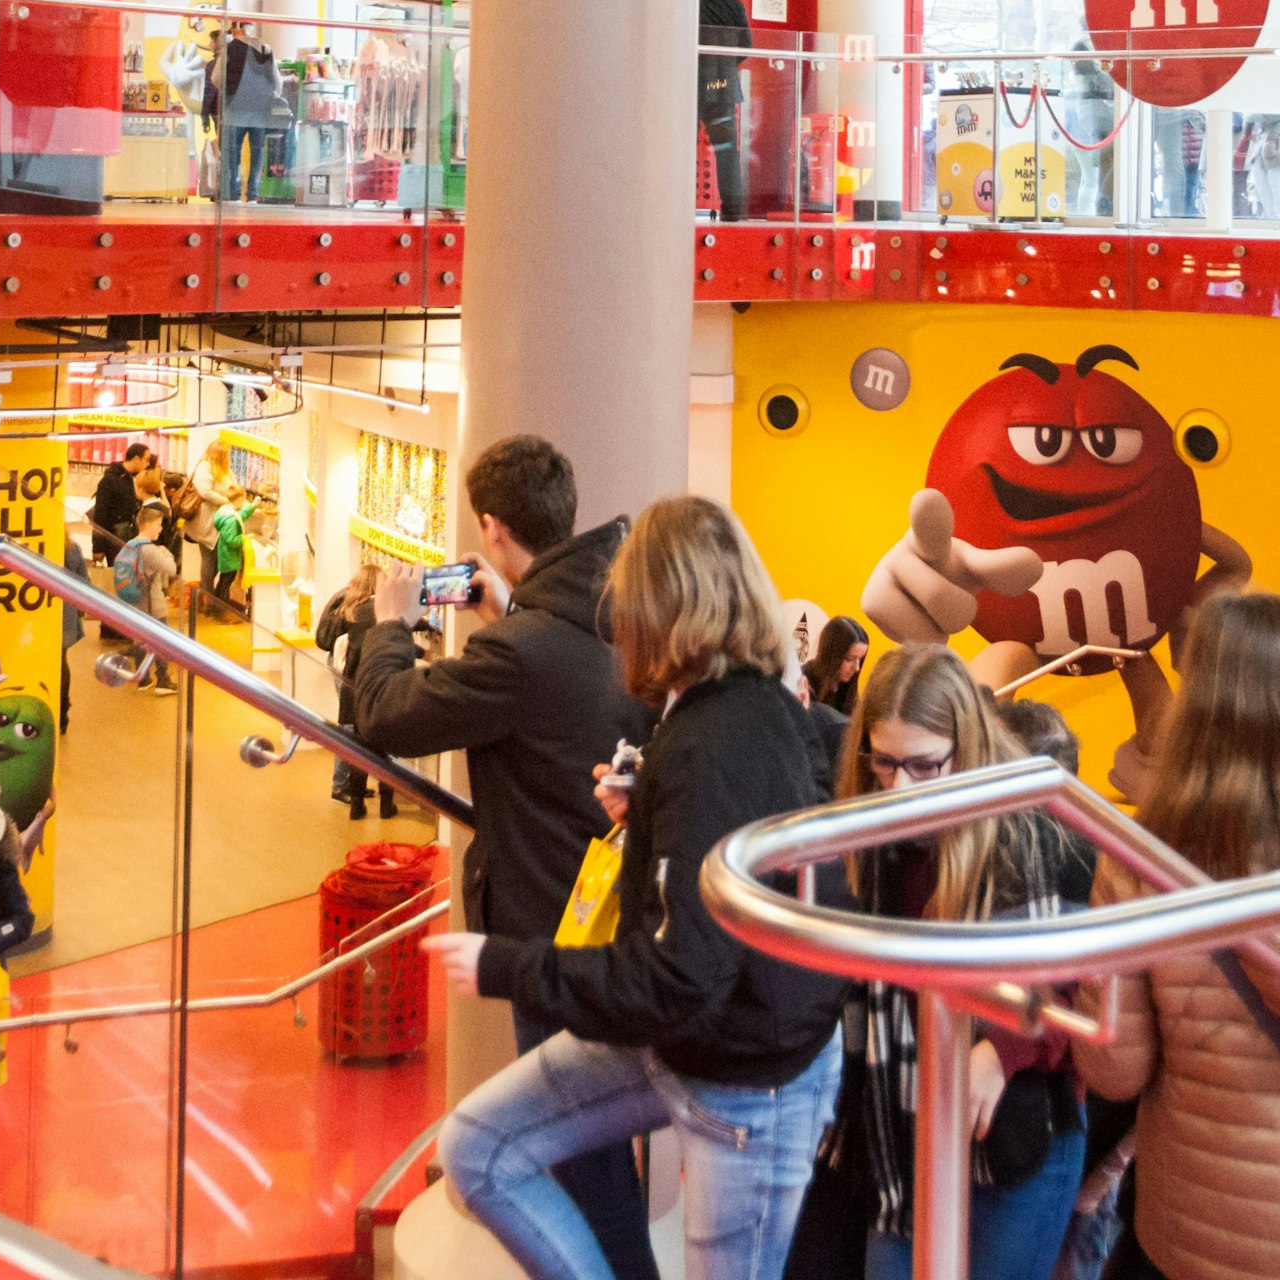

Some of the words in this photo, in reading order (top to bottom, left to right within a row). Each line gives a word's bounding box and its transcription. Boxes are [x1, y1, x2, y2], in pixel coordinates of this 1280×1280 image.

[863, 362, 896, 397] m
[115, 415, 146, 427] COLOUR
[1028, 550, 1157, 656] m
